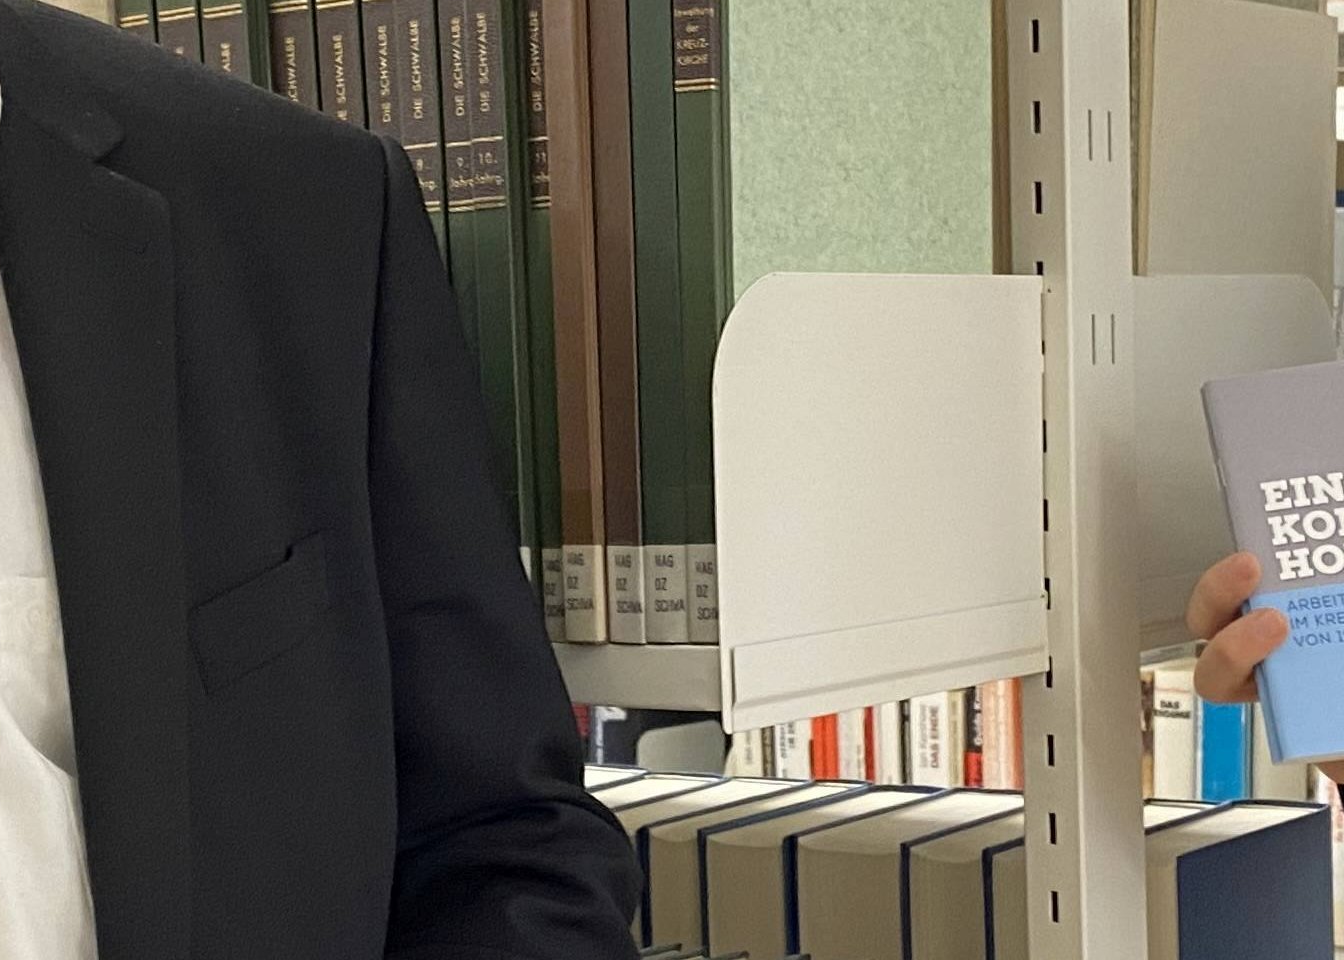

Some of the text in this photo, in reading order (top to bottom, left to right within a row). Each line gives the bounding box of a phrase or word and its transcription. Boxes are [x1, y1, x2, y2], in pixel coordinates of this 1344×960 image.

[332, 34, 347, 103] SCHWALBE
[378, 25, 391, 123] DIE SCHWALBE
[408, 19, 424, 120] DIE SCHWALBE
[451, 17, 465, 117] DIE SCHWALBE
[476, 12, 490, 112] DIE SCHWALBE
[529, 10, 543, 112] DIE SCHWALBE
[1260, 472, 1344, 512] EIN
[655, 555, 674, 568] MAG
[655, 599, 685, 613] SCHWA
[1291, 613, 1309, 629] IM
[1293, 632, 1332, 648] VON
[930, 706, 939, 769] DAS ENDE
